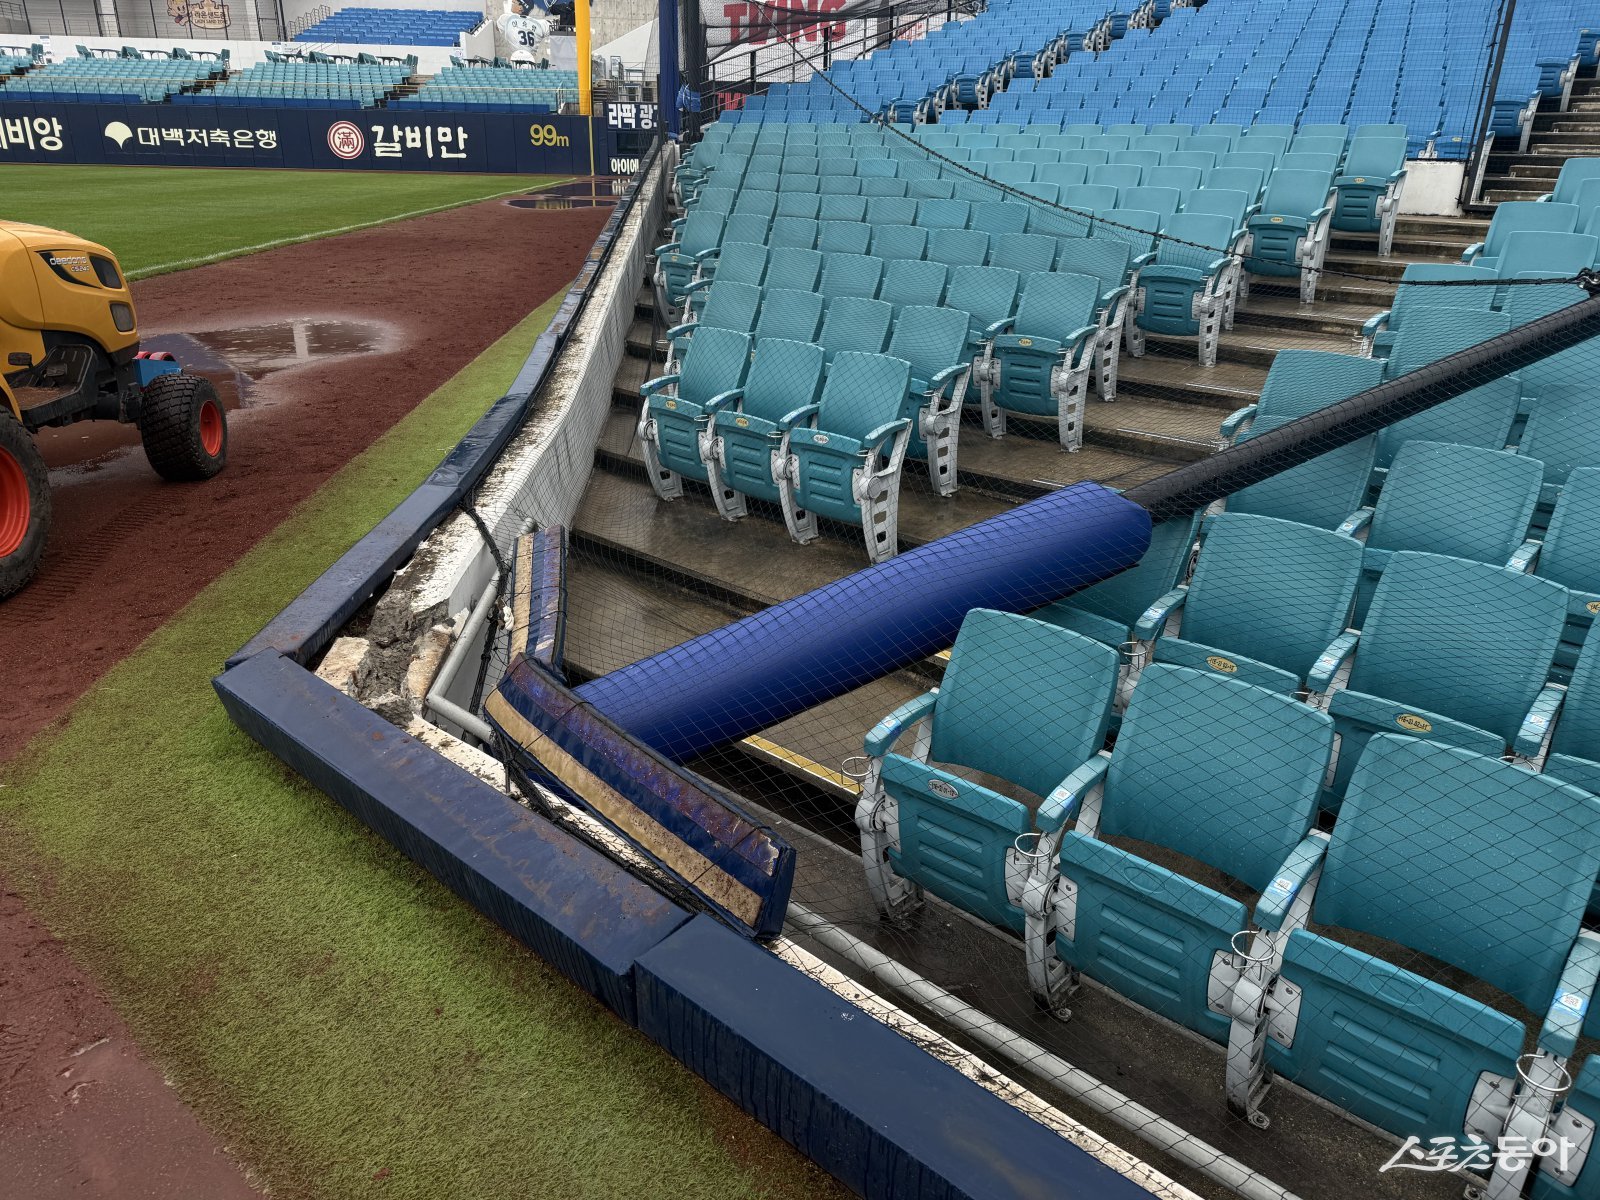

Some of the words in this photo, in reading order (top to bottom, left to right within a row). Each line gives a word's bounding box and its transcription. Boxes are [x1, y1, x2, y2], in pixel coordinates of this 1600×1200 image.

[518, 30, 535, 47] 36
[608, 103, 636, 129] 라팍
[0, 117, 64, 151] 비앙
[137, 126, 278, 149] 대백저축은행
[371, 125, 468, 159] 갈비만
[530, 124, 569, 147] 99m
